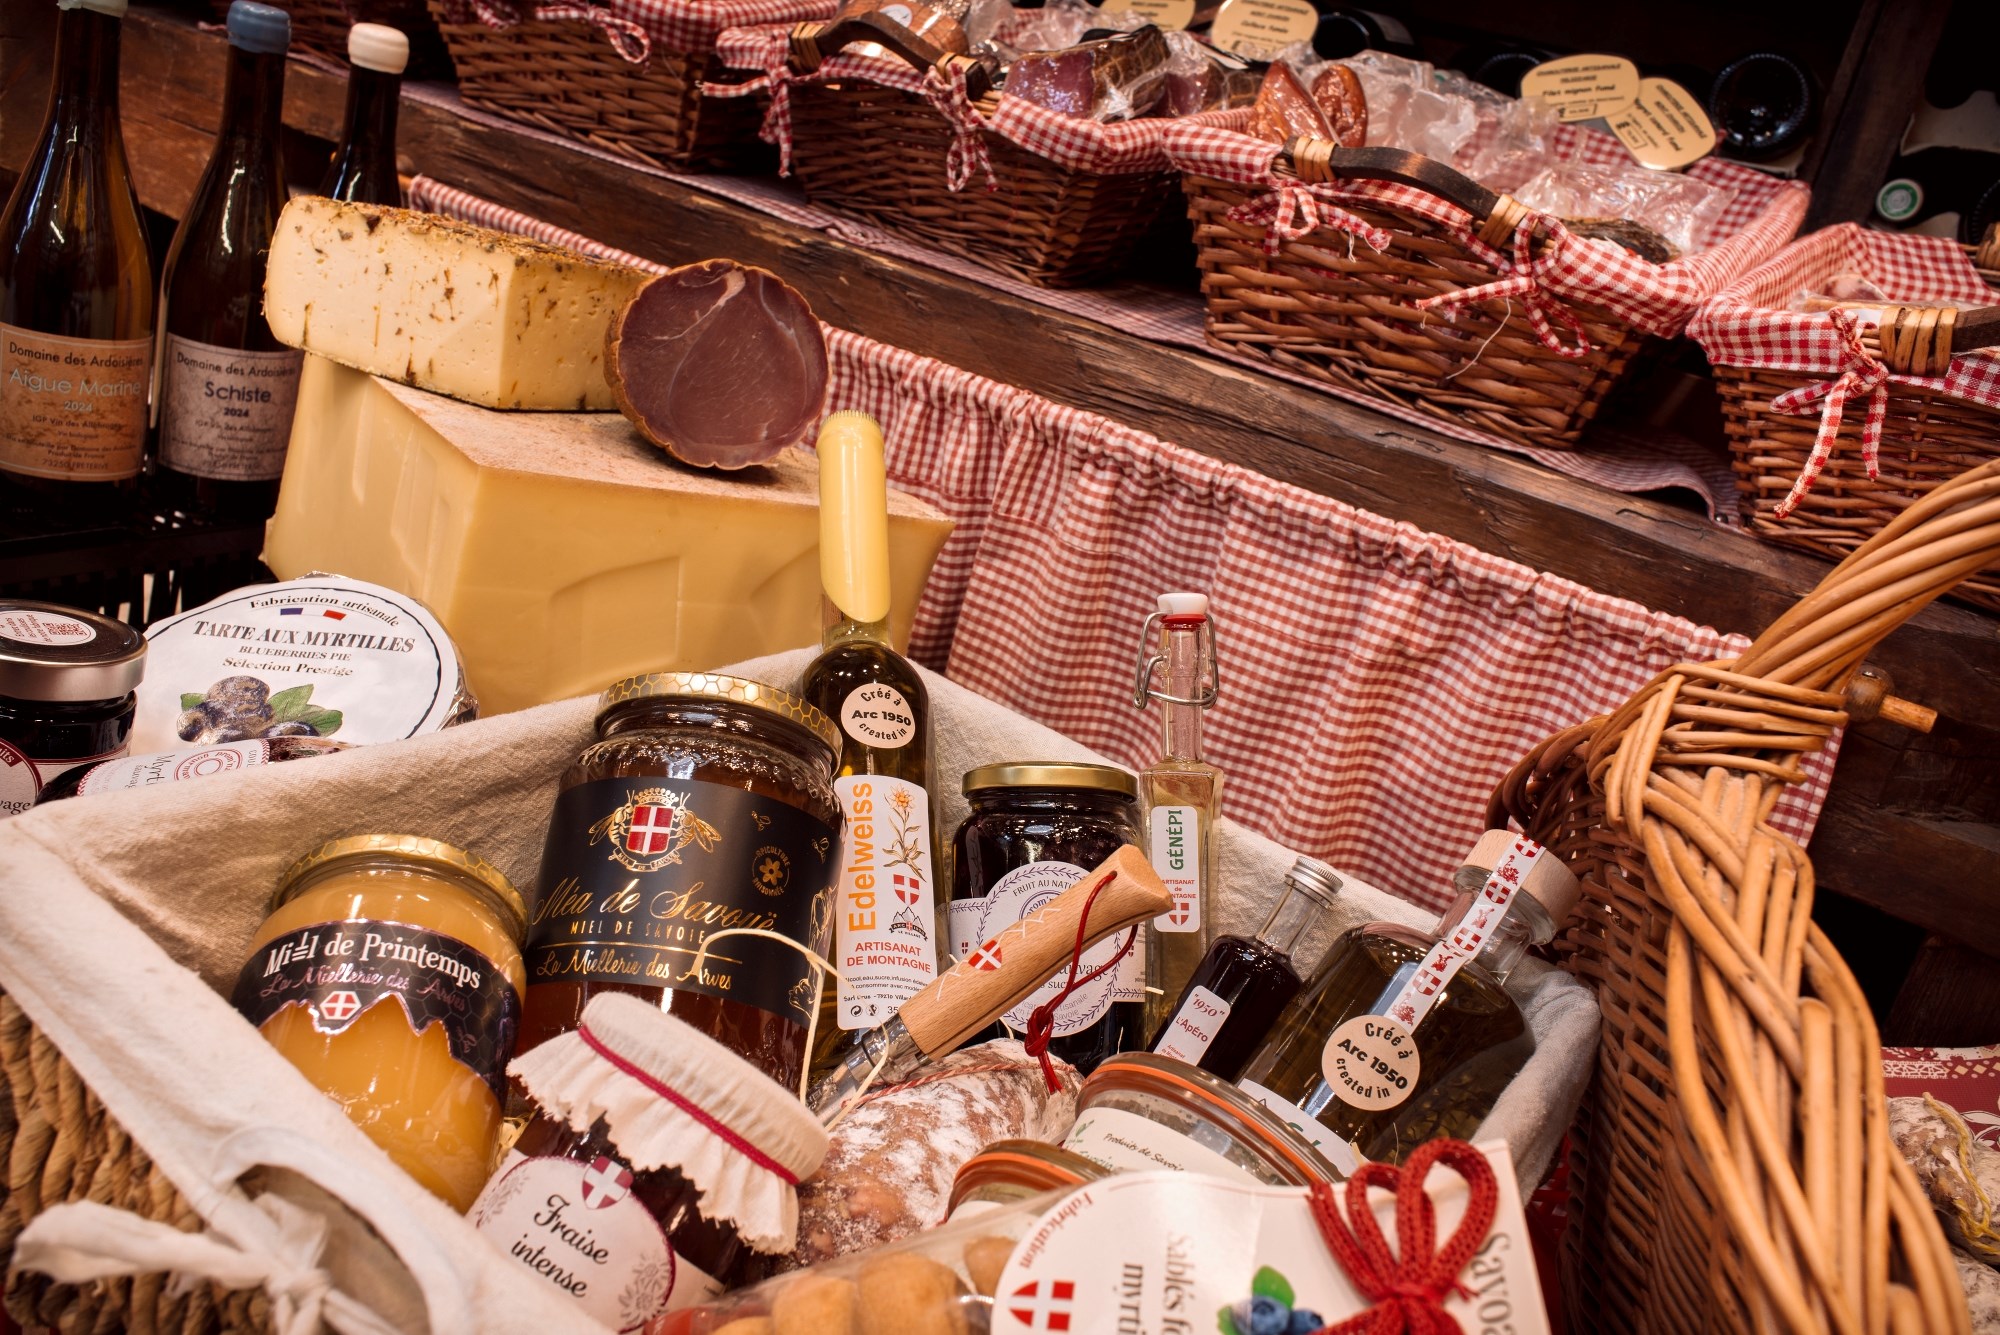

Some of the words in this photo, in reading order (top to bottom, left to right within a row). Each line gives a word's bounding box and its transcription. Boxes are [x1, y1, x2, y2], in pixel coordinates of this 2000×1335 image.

[9, 341, 60, 363] Domaine
[64, 352, 86, 366] des
[177, 351, 222, 373] Domaine
[225, 362, 244, 376] des
[79, 379, 141, 397] Marine
[204, 381, 272, 403] Schiste
[64, 401, 93, 412] 2024
[223, 407, 249, 418] 2024
[250, 594, 339, 609] Fabrication
[342, 600, 399, 627] artisanale
[192, 620, 256, 640] TARTE
[256, 627, 300, 645] AUX
[302, 630, 416, 653] MYRTILLES
[238, 645, 327, 660] BLUEBERRIES
[330, 652, 351, 661] PIE
[222, 656, 291, 673] Sélection
[294, 663, 353, 677] Prestige
[860, 687, 892, 702] Créé
[893, 697, 902, 707] à
[851, 709, 878, 720] Arc
[882, 711, 912, 726] 1950
[859, 722, 898, 740] created
[898, 728, 908, 738] in
[1165, 810, 1184, 870] GÉNÉPI
[755, 845, 791, 867] APICULTURE
[848, 782, 877, 932] Edelweiss
[1012, 880, 1036, 896] FRUIT
[1037, 879, 1051, 887] AU
[530, 877, 593, 926] Méa
[599, 878, 641, 914] de
[570, 919, 603, 935] MIEL
[614, 920, 632, 936] DE
[645, 924, 705, 944] SAVOIE
[323, 931, 355, 957] de
[358, 933, 481, 990] Printemps
[855, 941, 922, 957] ARTISANAT
[536, 951, 562, 976] La
[561, 948, 642, 976] Miellerie
[645, 952, 670, 979] des
[846, 957, 864, 967] DE
[867, 955, 932, 974] MONTAGNE
[386, 968, 409, 991] des
[1364, 1022, 1402, 1046] Créé
[1398, 1049, 1413, 1060] à
[1337, 1038, 1369, 1062] Arc
[1370, 1056, 1409, 1090] 1950
[1335, 1057, 1373, 1099] created
[1376, 1086, 1391, 1099] in
[1103, 1133, 1139, 1151] Produits
[1138, 1147, 1151, 1157] de
[533, 1193, 610, 1265] Fraise
[1019, 1191, 1094, 1270] Fabrication
[511, 1233, 588, 1298] intense
[1164, 1231, 1196, 1312] Sablés
